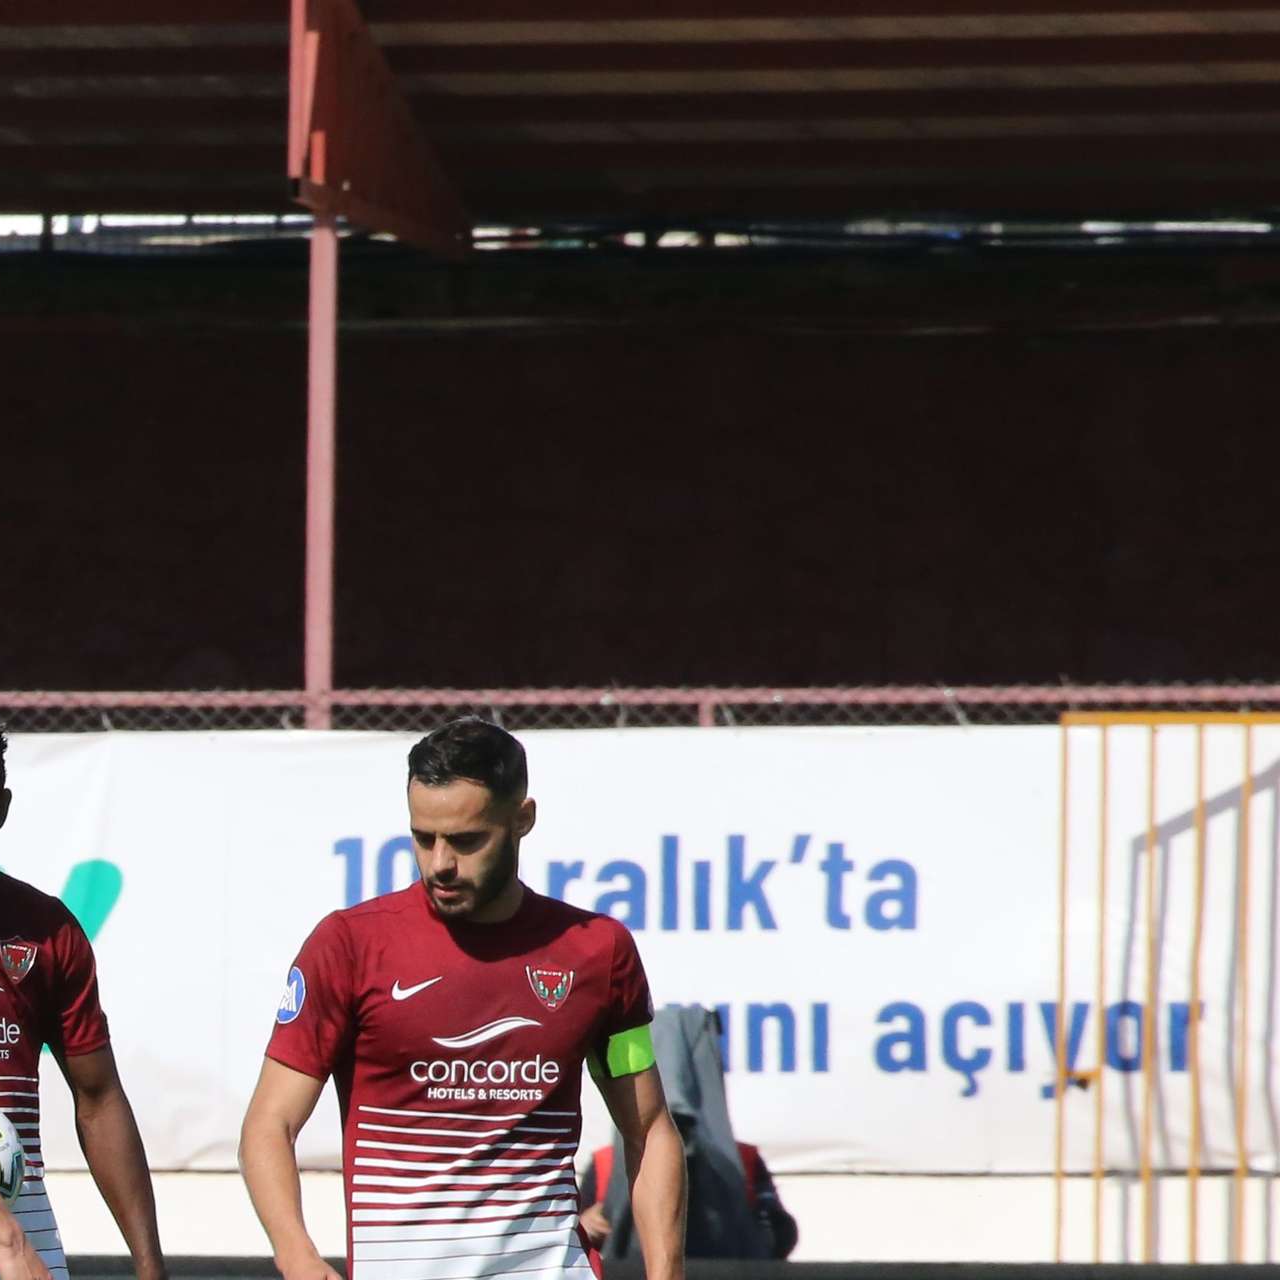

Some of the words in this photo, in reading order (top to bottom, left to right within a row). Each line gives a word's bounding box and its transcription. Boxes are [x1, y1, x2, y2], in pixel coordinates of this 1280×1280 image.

[547, 833, 919, 932] ralık'ta
[409, 1053, 560, 1084] concorde
[426, 1086, 476, 1100] HOTELS
[477, 1087, 487, 1100] &
[489, 1087, 544, 1101] RESORTS
